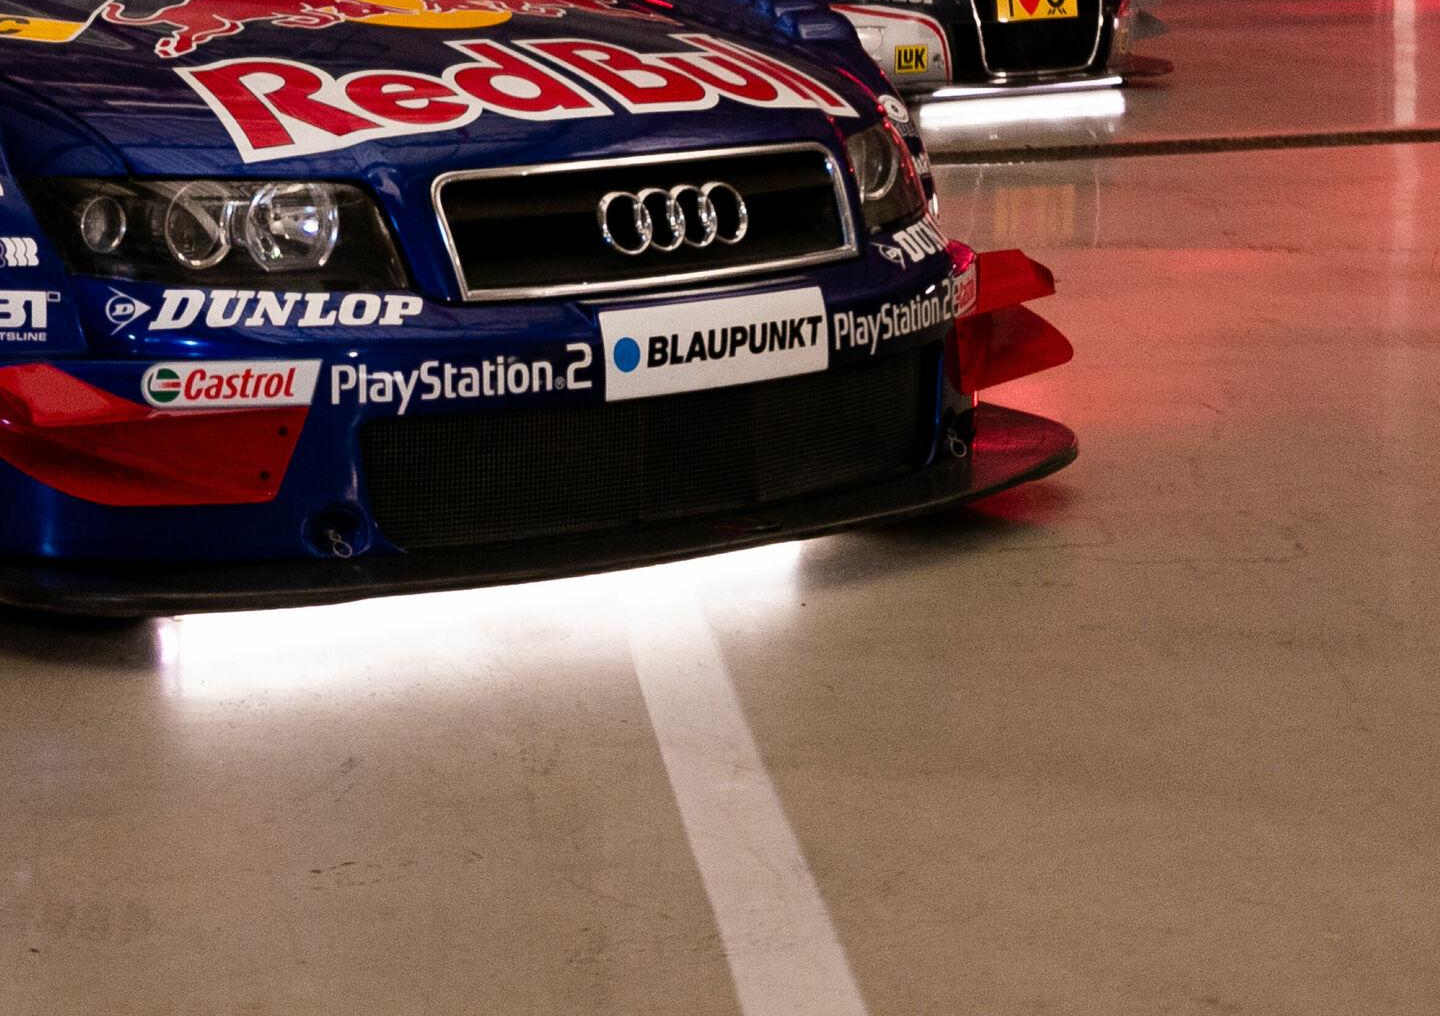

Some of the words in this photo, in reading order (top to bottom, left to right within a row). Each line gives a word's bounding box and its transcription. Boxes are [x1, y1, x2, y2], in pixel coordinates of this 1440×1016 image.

[149, 288, 424, 331] DUNLOP
[834, 294, 940, 355] PlayStation
[646, 315, 823, 368] BLAUPUNKT
[184, 367, 296, 401] Castrol
[331, 355, 553, 416] PlayStation
[566, 342, 593, 390] 2
